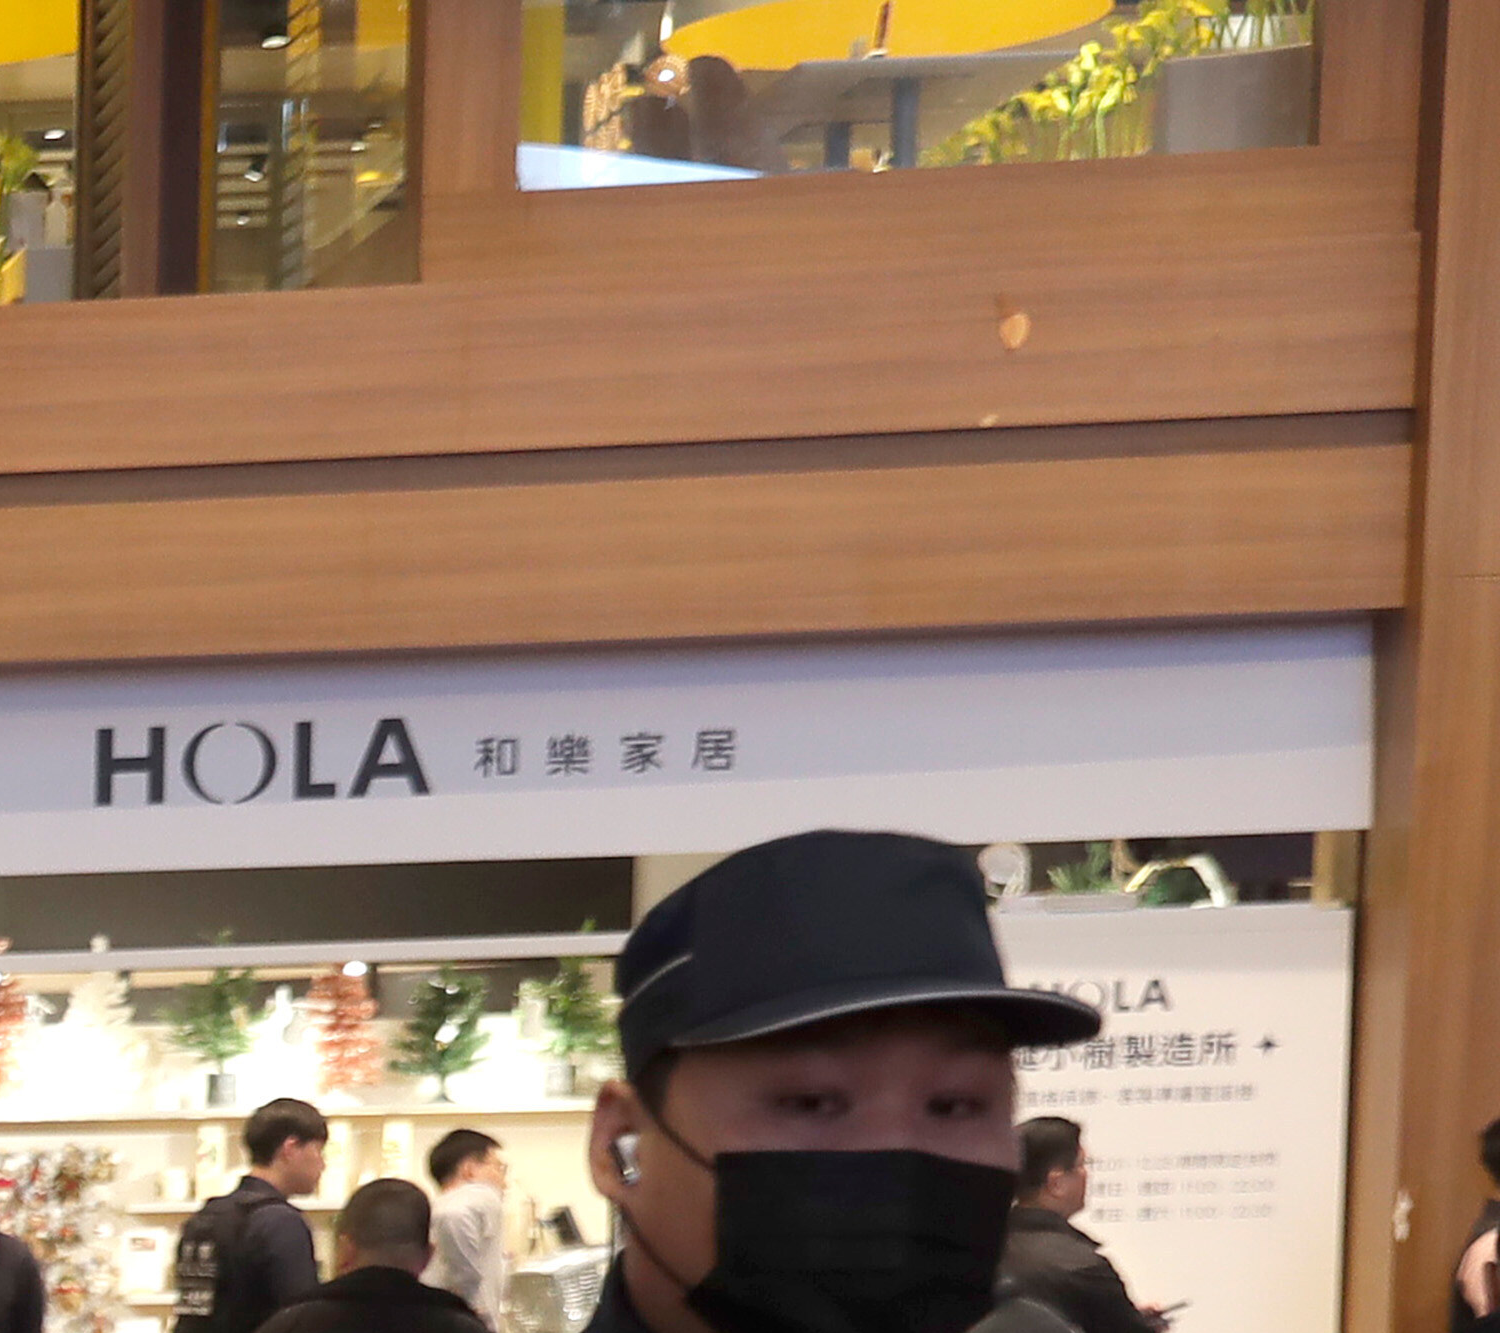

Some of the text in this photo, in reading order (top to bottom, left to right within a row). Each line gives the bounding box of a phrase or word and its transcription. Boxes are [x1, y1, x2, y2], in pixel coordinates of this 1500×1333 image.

[94, 716, 737, 807] HOLA 和樂家居
